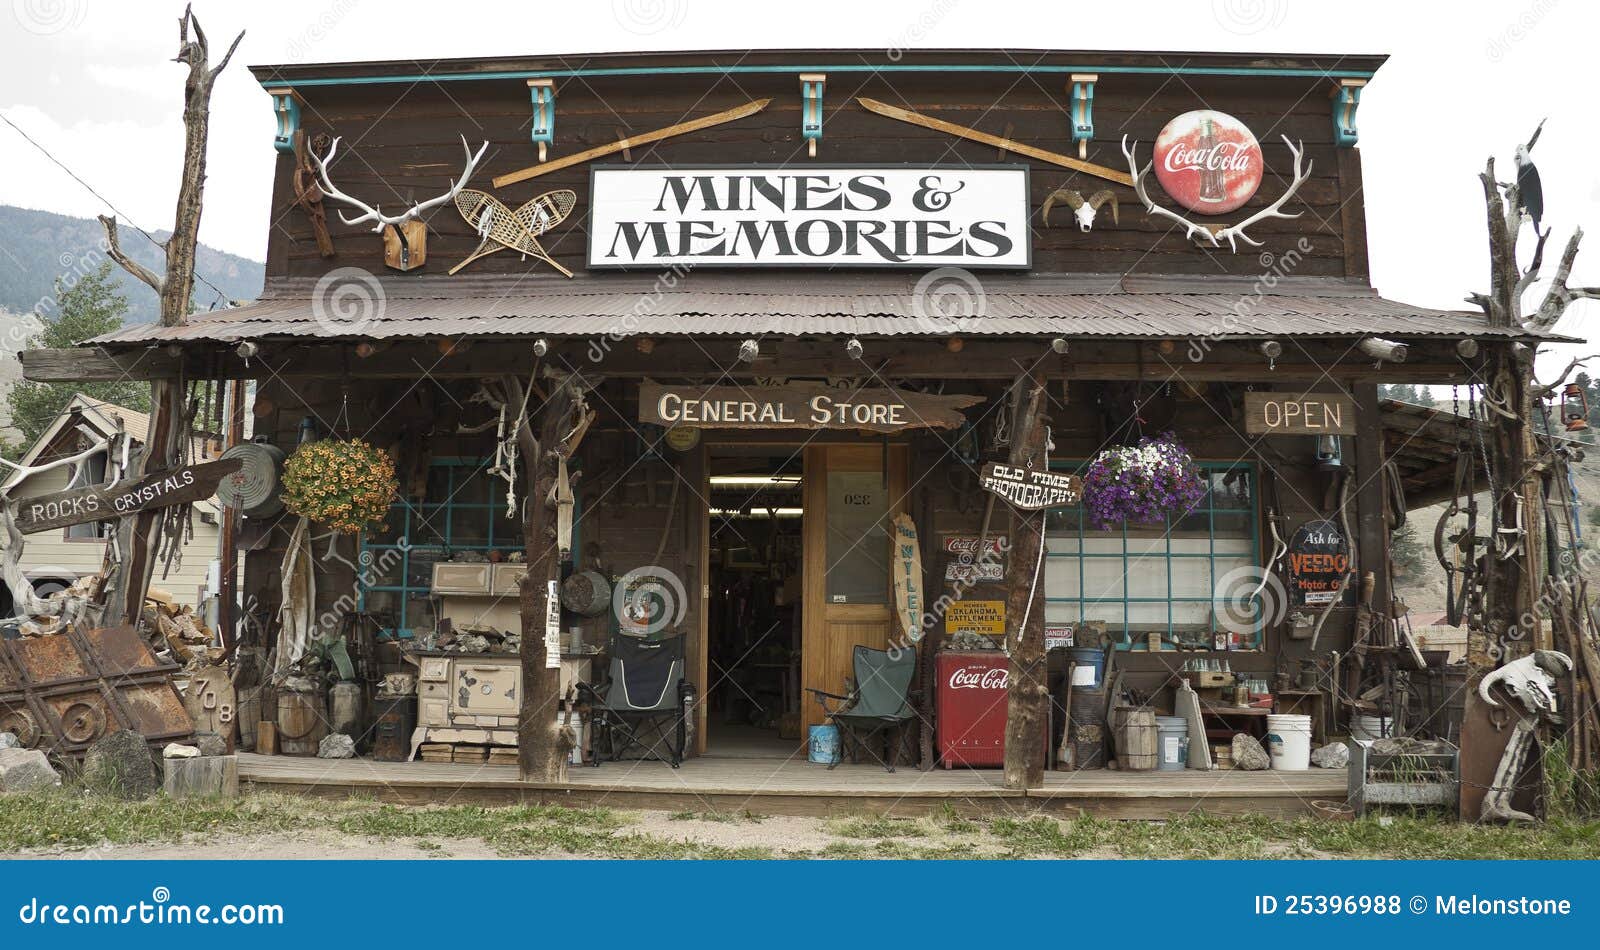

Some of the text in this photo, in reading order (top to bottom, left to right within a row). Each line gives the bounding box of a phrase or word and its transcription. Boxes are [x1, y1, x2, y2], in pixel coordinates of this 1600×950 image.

[1164, 141, 1250, 172] Coca-Cola
[653, 176, 965, 214] MINES &
[605, 220, 1014, 262] MEMORIES
[658, 393, 909, 425] GENERAL STORE
[1264, 401, 1341, 428] OPEN
[984, 477, 1076, 508] PHOTOGRAPHY
[993, 465, 1070, 489] OLD TIME
[31, 470, 195, 523] ROCKS CRYSTALS
[1304, 532, 1340, 545] Ask for
[1299, 579, 1327, 590] Motor
[1054, 639, 1072, 647] POINT
